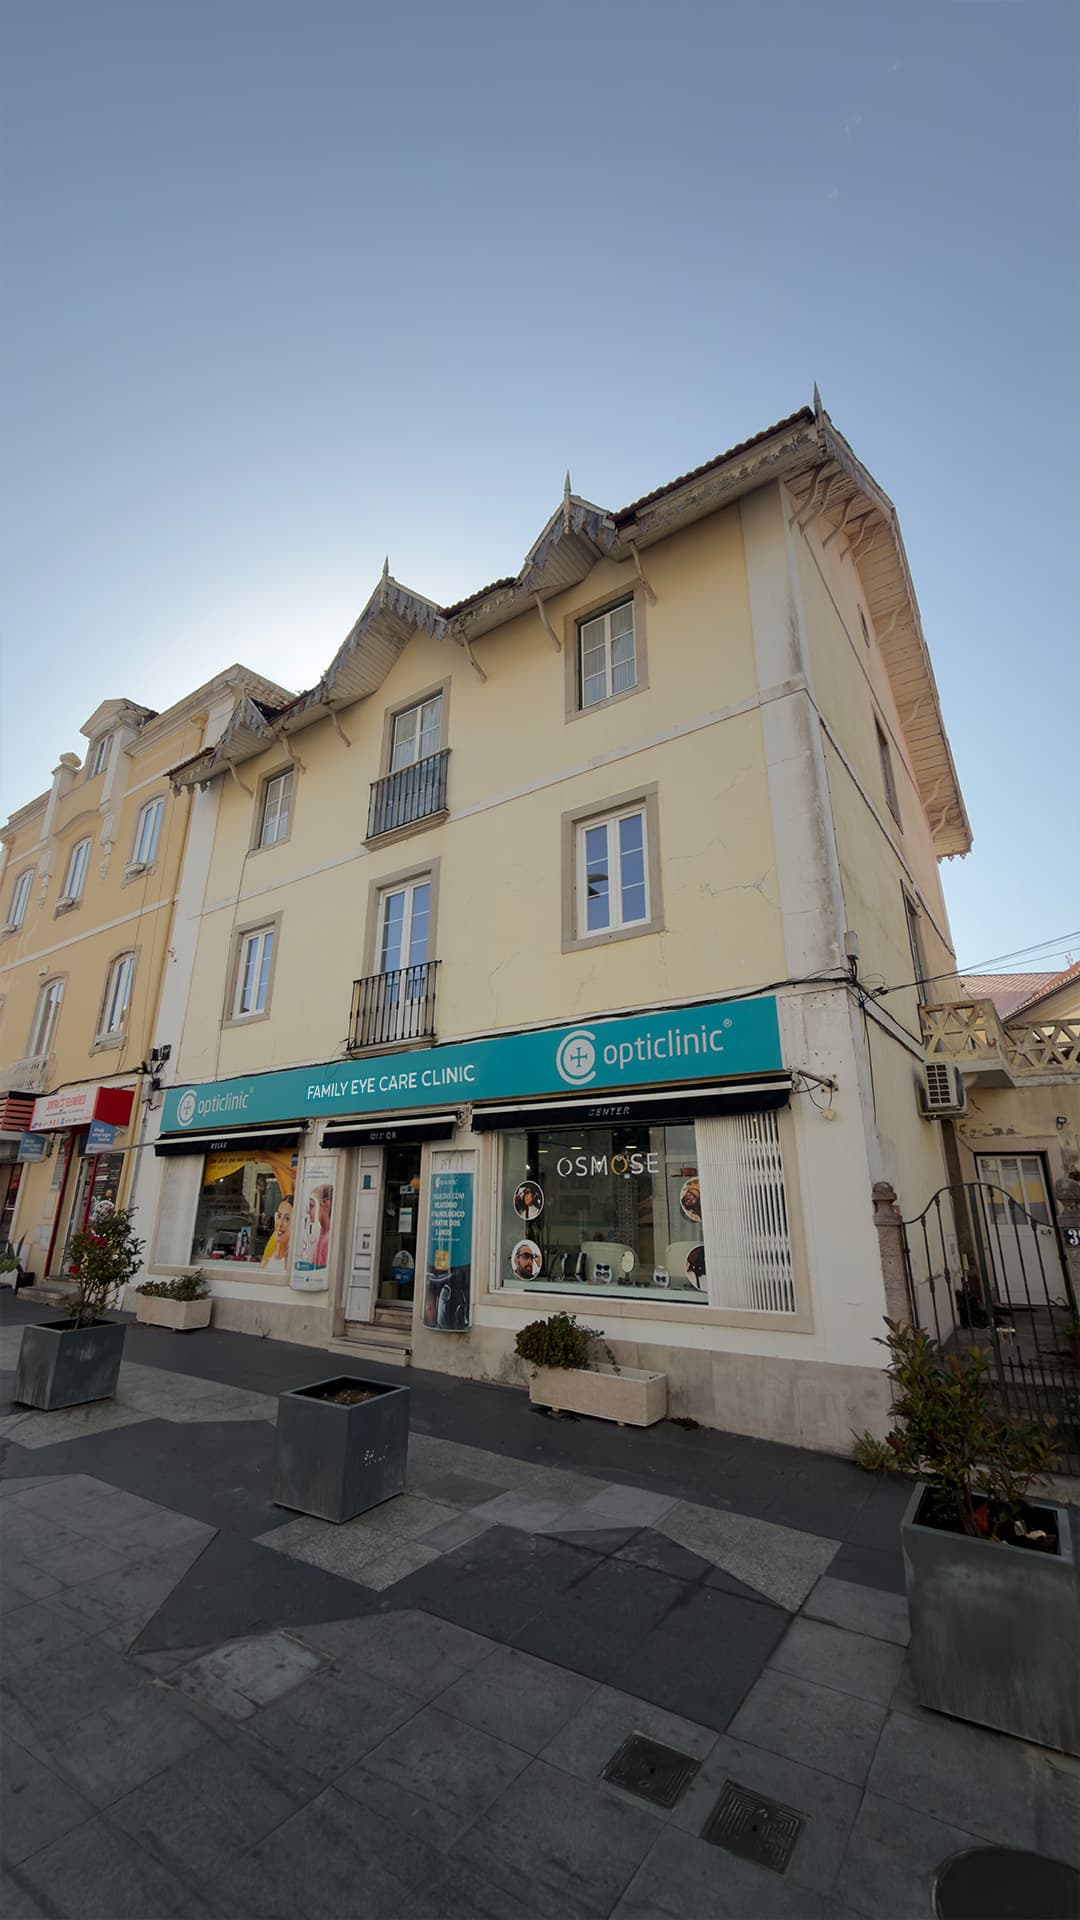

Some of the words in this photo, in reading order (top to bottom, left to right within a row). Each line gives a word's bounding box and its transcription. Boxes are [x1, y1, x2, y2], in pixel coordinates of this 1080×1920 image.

[603, 1024, 724, 1070] opticlinic
[307, 1080, 349, 1100] FAMILY
[351, 1077, 376, 1096] EYE
[379, 1072, 417, 1092] CARE
[421, 1064, 476, 1087] CLINIC
[197, 1090, 249, 1117] opticlinic
[588, 1106, 630, 1116] CENTER
[556, 1152, 660, 1178] OSMOSE
[1068, 1228, 1080, 1246] 3
